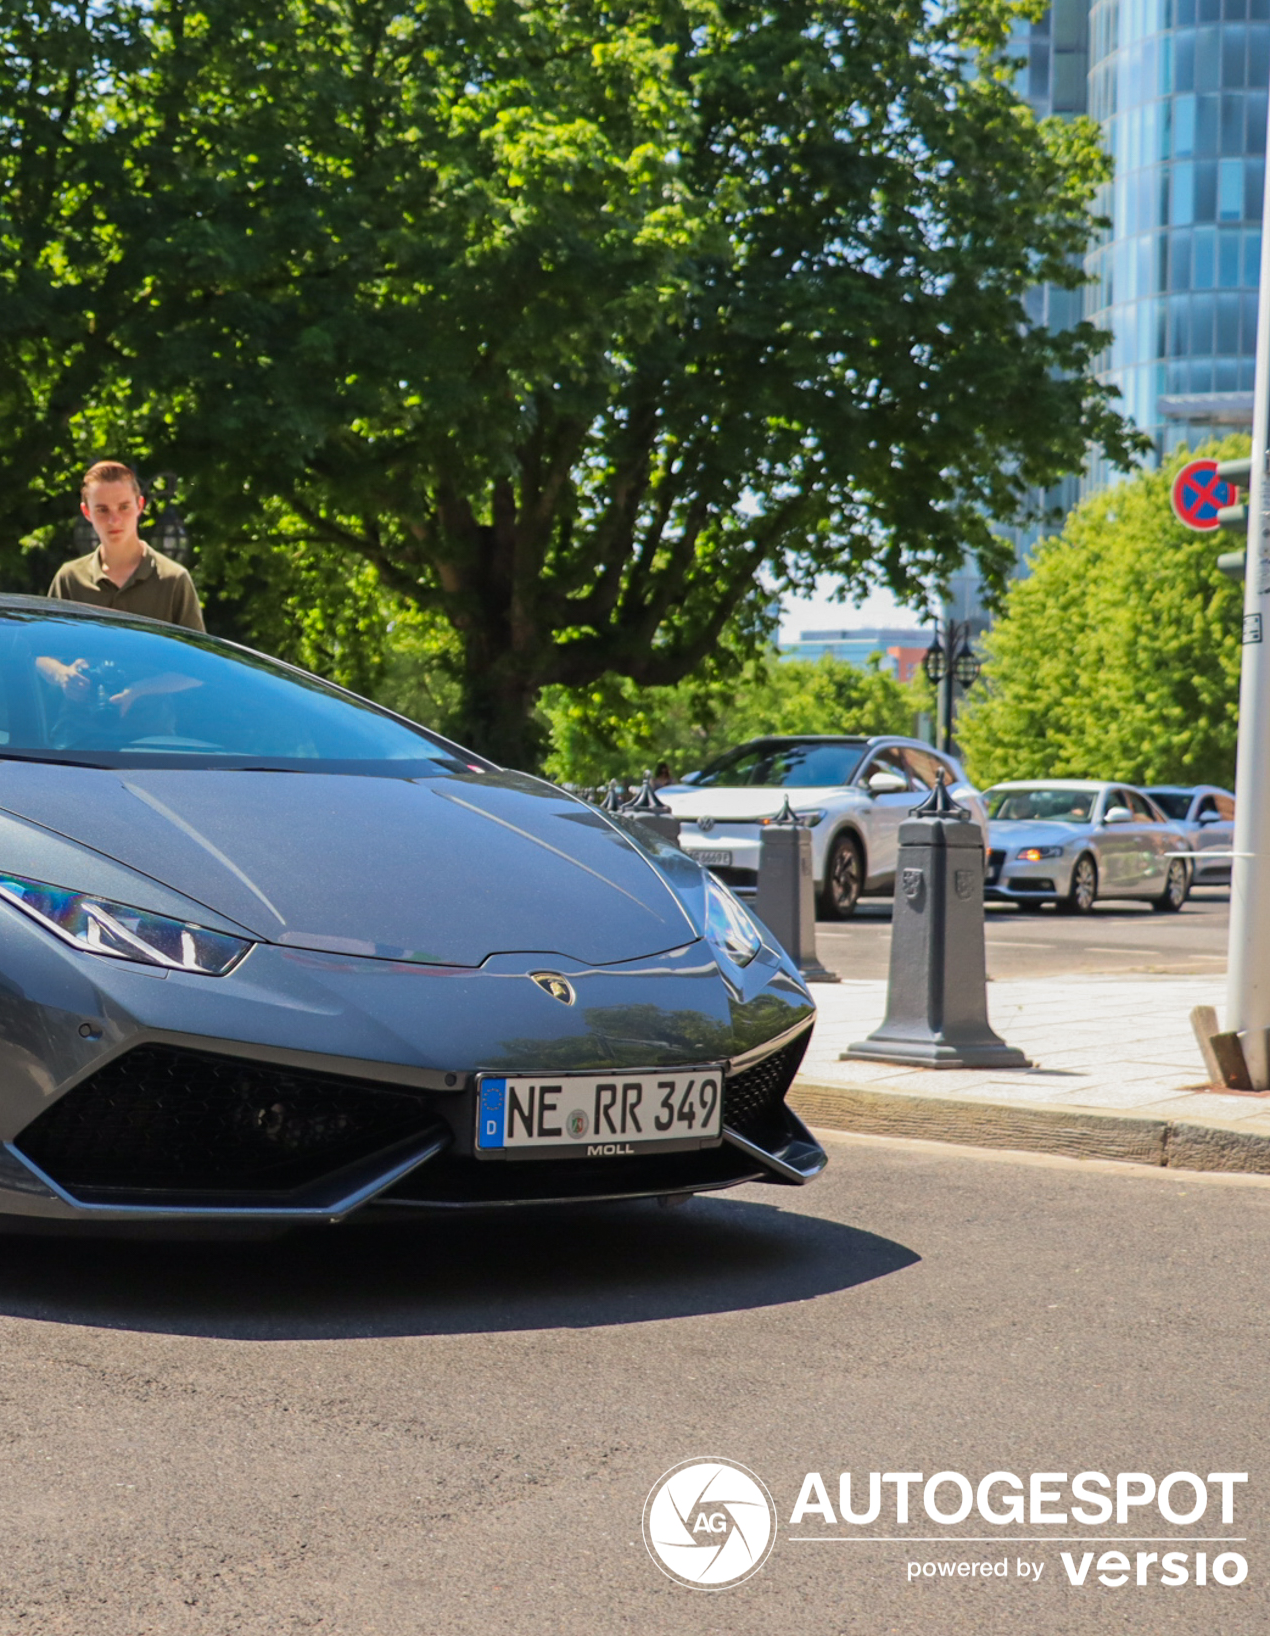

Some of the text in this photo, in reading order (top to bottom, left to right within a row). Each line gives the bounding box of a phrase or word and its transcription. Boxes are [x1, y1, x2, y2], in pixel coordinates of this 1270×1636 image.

[487, 1079, 718, 1138] D NE RR 349
[587, 1144, 635, 1156] MOLL
